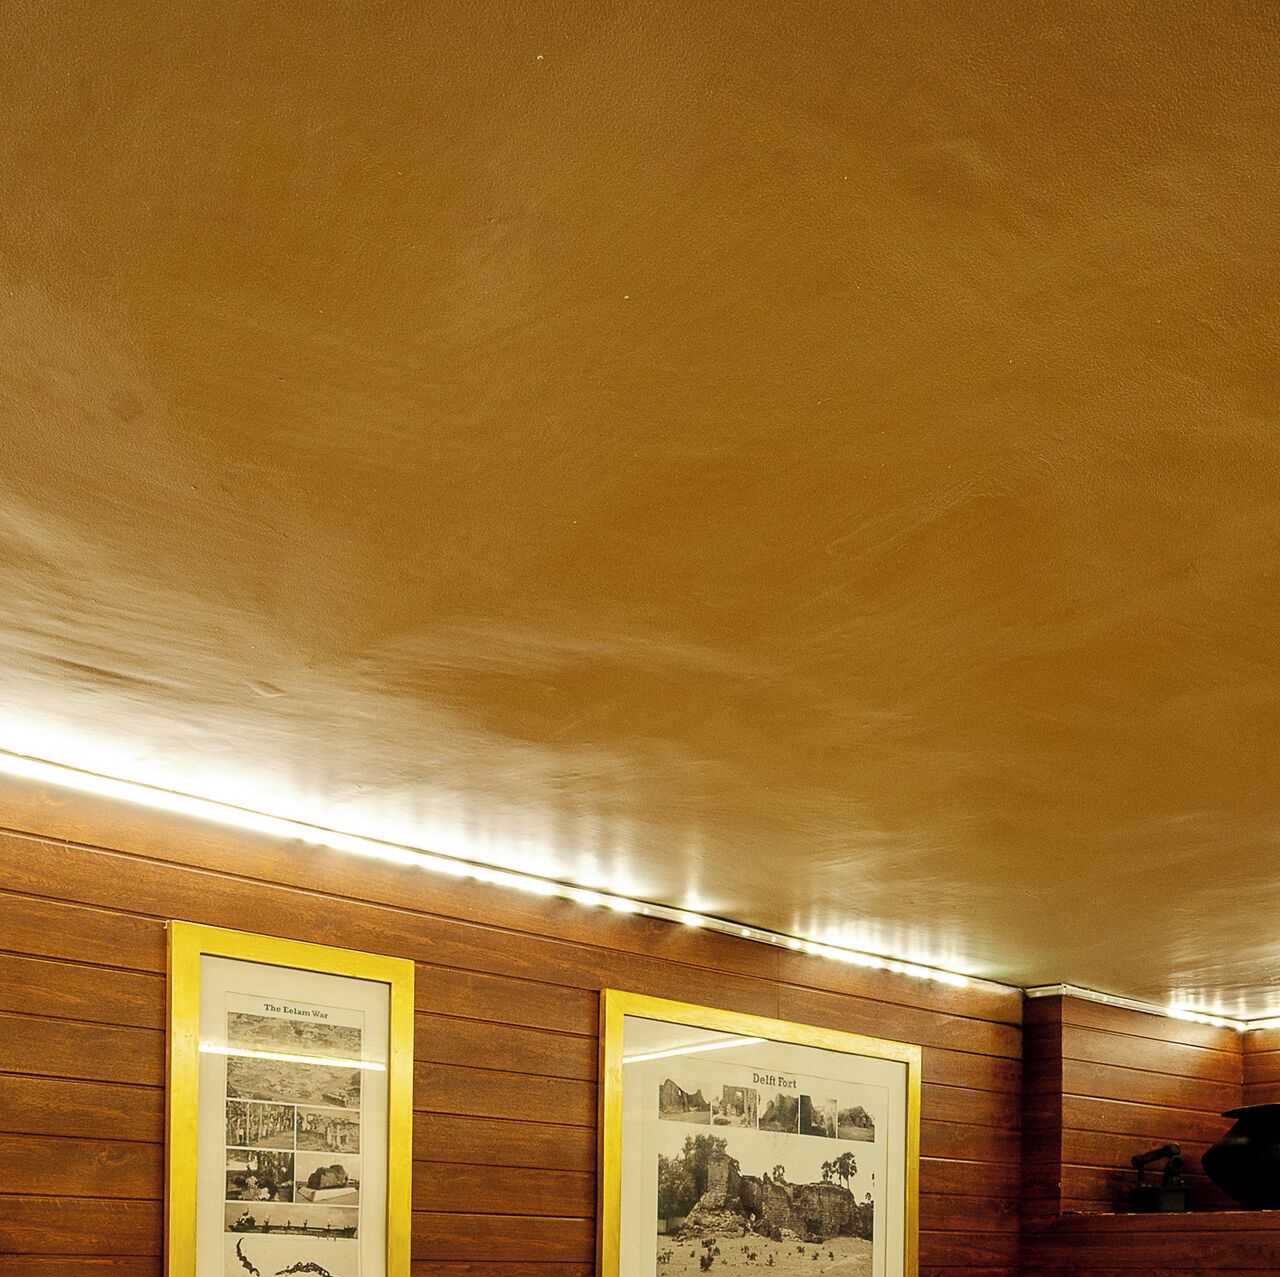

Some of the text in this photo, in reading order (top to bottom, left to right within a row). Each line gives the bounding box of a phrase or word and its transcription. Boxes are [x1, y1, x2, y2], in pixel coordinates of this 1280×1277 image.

[264, 1004, 328, 1019] The Eelam War
[753, 1073, 796, 1088] Delft Fort
